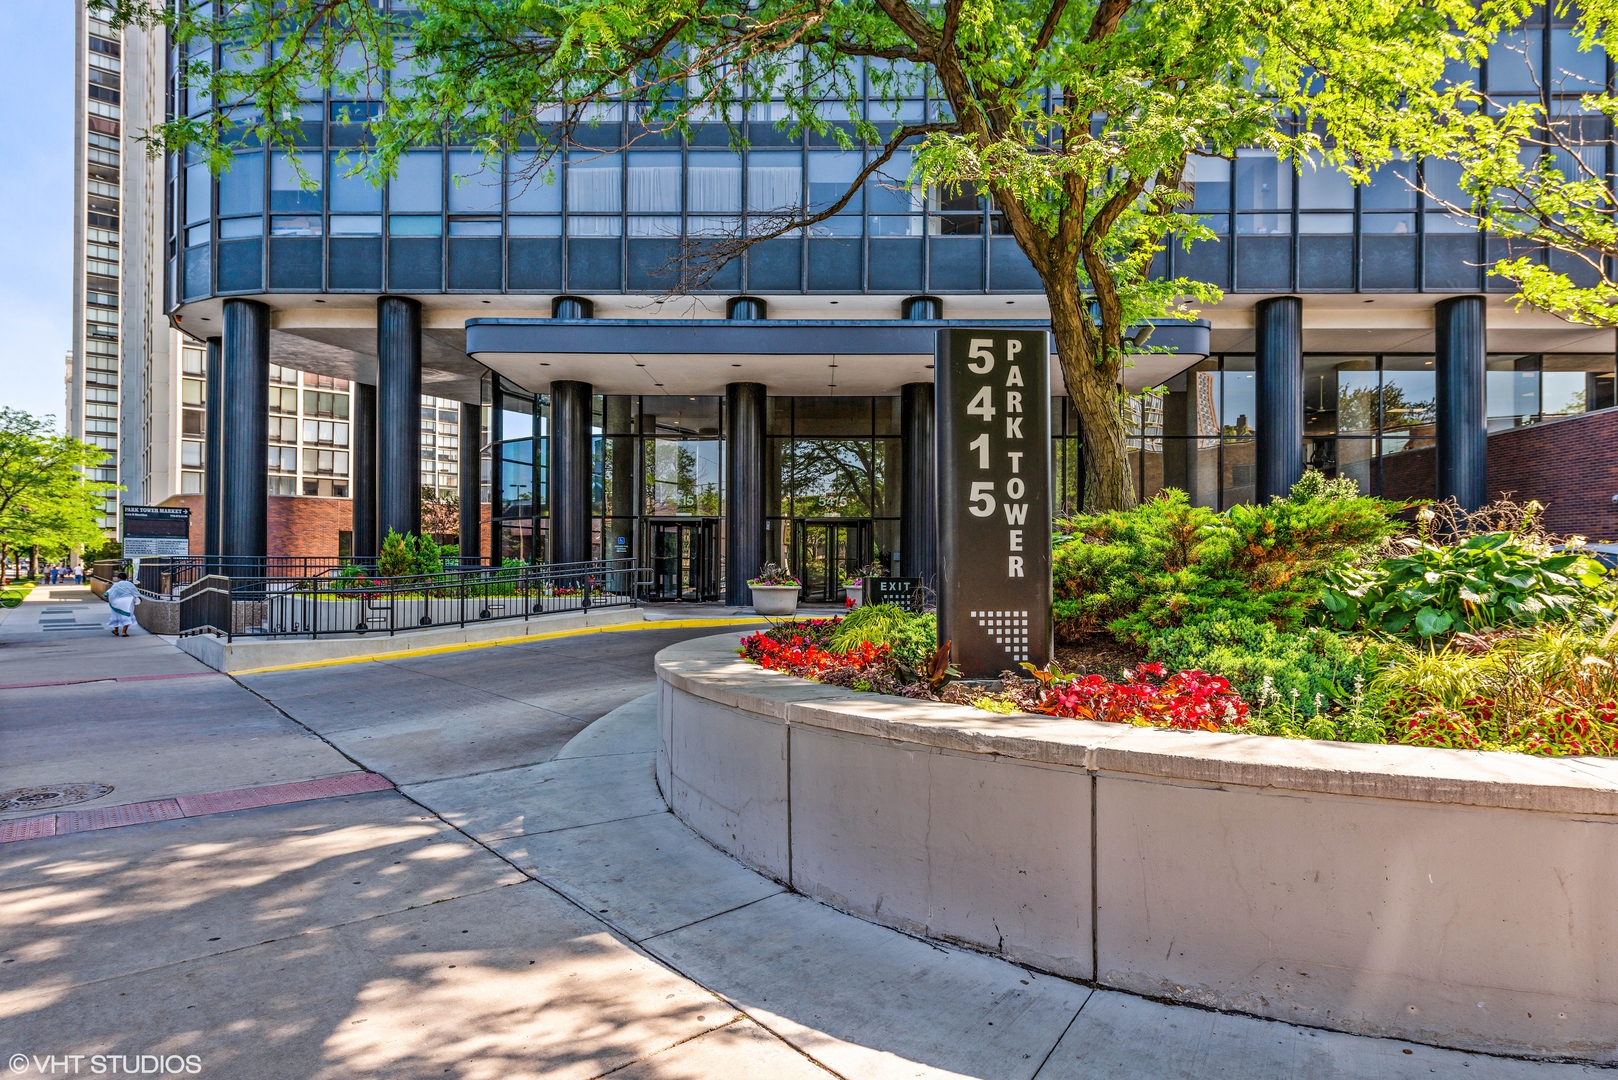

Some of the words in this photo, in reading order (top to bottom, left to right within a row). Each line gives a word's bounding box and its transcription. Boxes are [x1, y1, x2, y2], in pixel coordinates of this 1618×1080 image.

[966, 338, 996, 518] 5415
[1006, 339, 1025, 439] PARK
[818, 496, 848, 507] 5415
[1003, 451, 1029, 578] TOWER
[880, 581, 911, 591] EXIT
